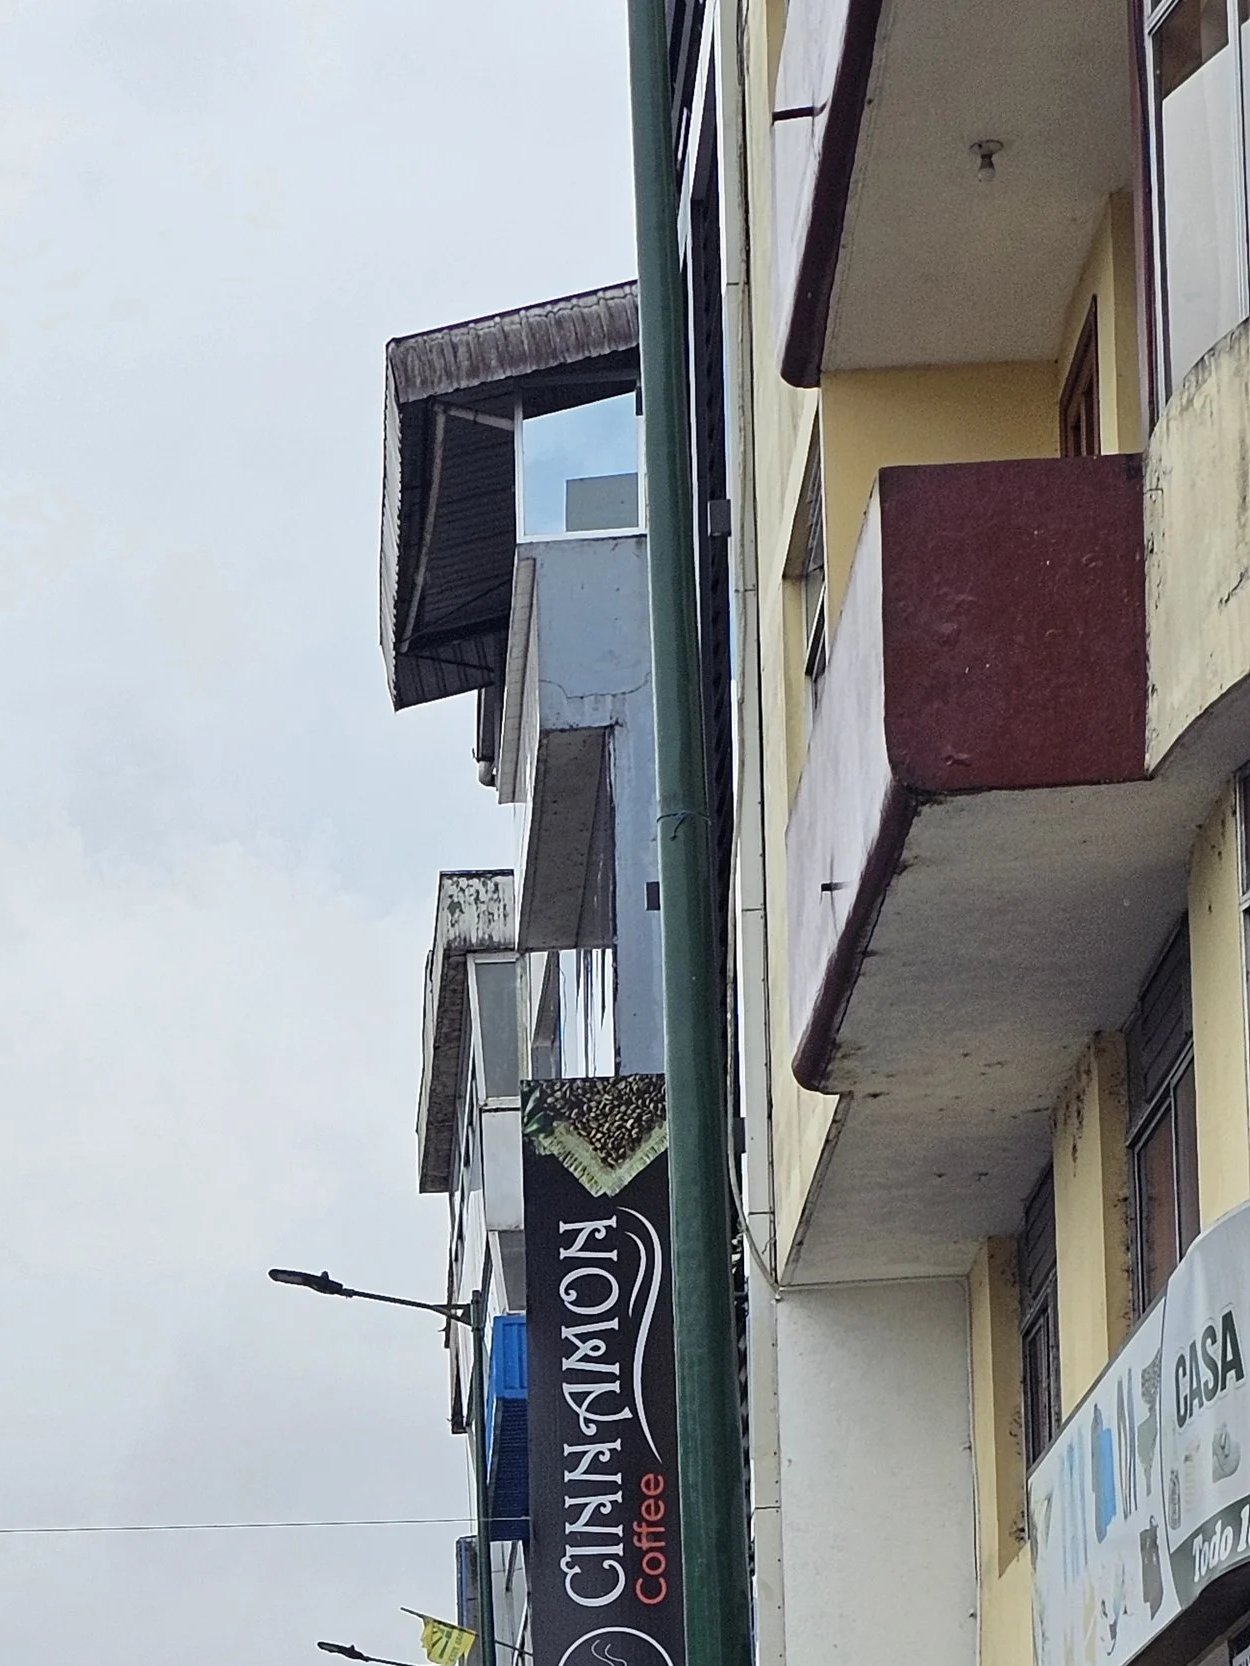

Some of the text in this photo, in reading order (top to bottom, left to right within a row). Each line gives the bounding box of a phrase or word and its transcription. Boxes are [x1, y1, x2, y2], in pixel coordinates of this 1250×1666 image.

[558, 1215, 633, 1608] CINNAMON
[1175, 1310, 1245, 1428] CASA
[633, 1472, 668, 1605] Coffee
[1192, 1503, 1250, 1583] Todo I
